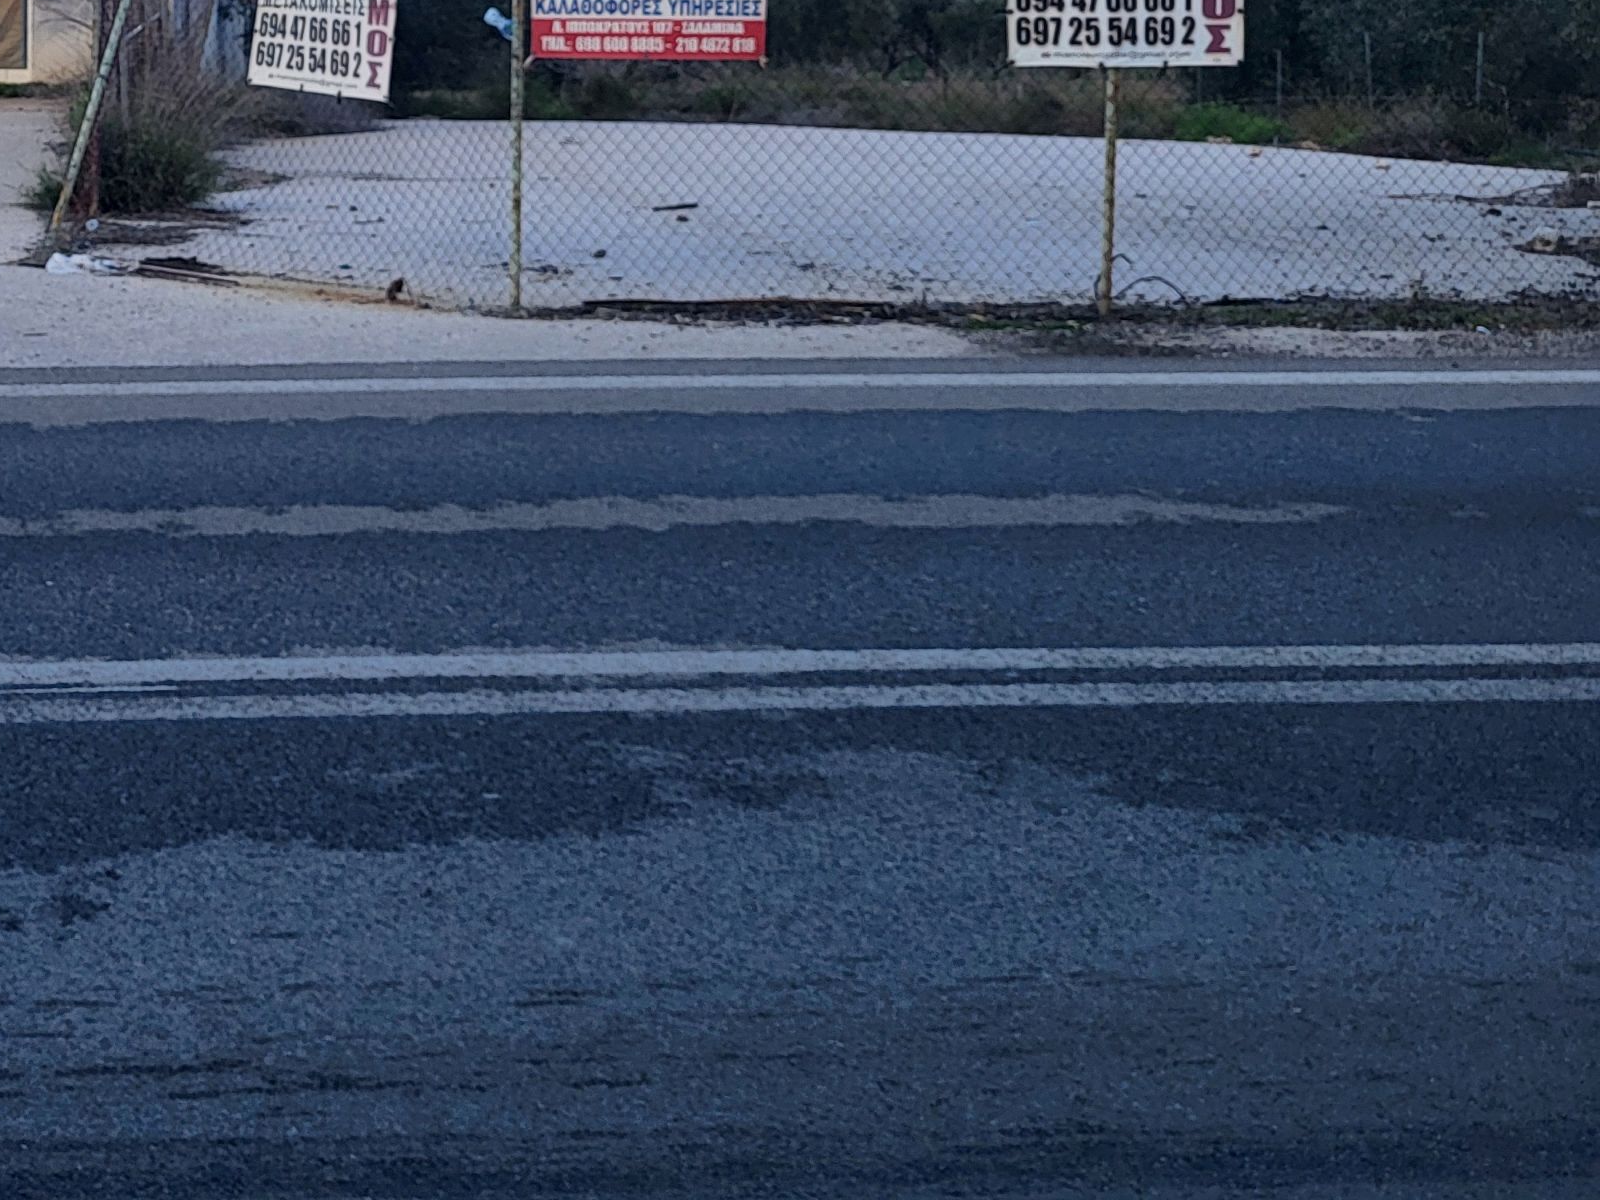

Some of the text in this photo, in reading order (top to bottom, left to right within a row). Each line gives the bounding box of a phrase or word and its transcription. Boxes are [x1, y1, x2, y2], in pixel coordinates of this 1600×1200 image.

[259, 12, 362, 48] 694 47 66 66 1
[1015, 16, 1196, 46] 697 25 54 69 2
[255, 41, 362, 78] 697 25 54 69 2
